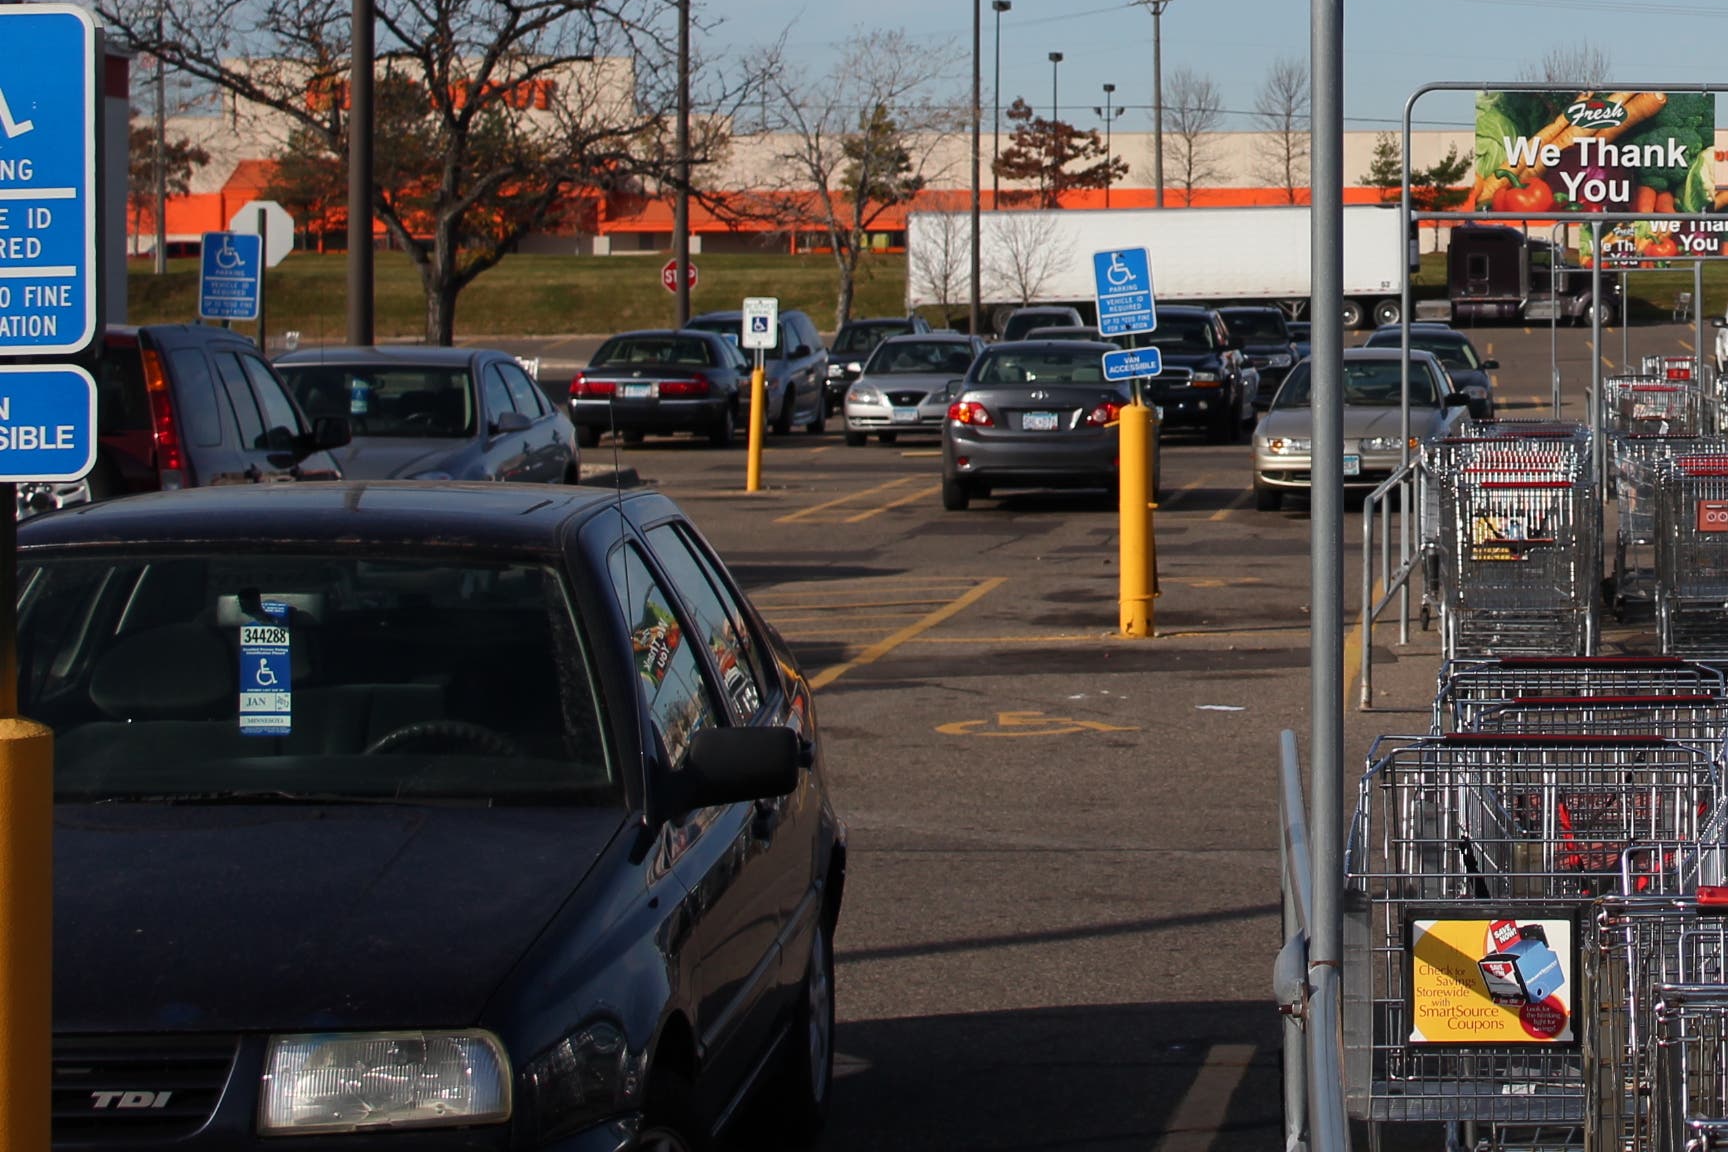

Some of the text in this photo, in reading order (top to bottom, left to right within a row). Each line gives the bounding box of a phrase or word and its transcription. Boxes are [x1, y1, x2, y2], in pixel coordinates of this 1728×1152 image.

[1567, 100, 1625, 127] Fresh
[1502, 135, 1688, 168] We Thank
[1560, 171, 1630, 203] You
[28, 207, 52, 229] ID
[1650, 219, 1681, 233] We
[1679, 234, 1719, 252] You
[24, 284, 73, 308] FINE
[1108, 284, 1138, 294] PARKING
[1105, 296, 1145, 307] VEHICLE ID
[1108, 302, 1143, 313] REQUIRED
[1108, 361, 1157, 374] ACCESSIBLE
[1123, 356, 1141, 365] VAN
[244, 627, 287, 645] 344288
[246, 697, 267, 707] JAN
[1493, 923, 1511, 939] SAVE
[1499, 928, 1517, 944] NOW!
[1418, 964, 1466, 976] Check for
[1435, 975, 1477, 989] Savings
[1416, 986, 1470, 998] Storewide
[1431, 998, 1451, 1007] with
[1419, 1004, 1499, 1018] SmartSource
[1447, 1016, 1505, 1033] Coupons
[91, 1090, 173, 1109] TDI
